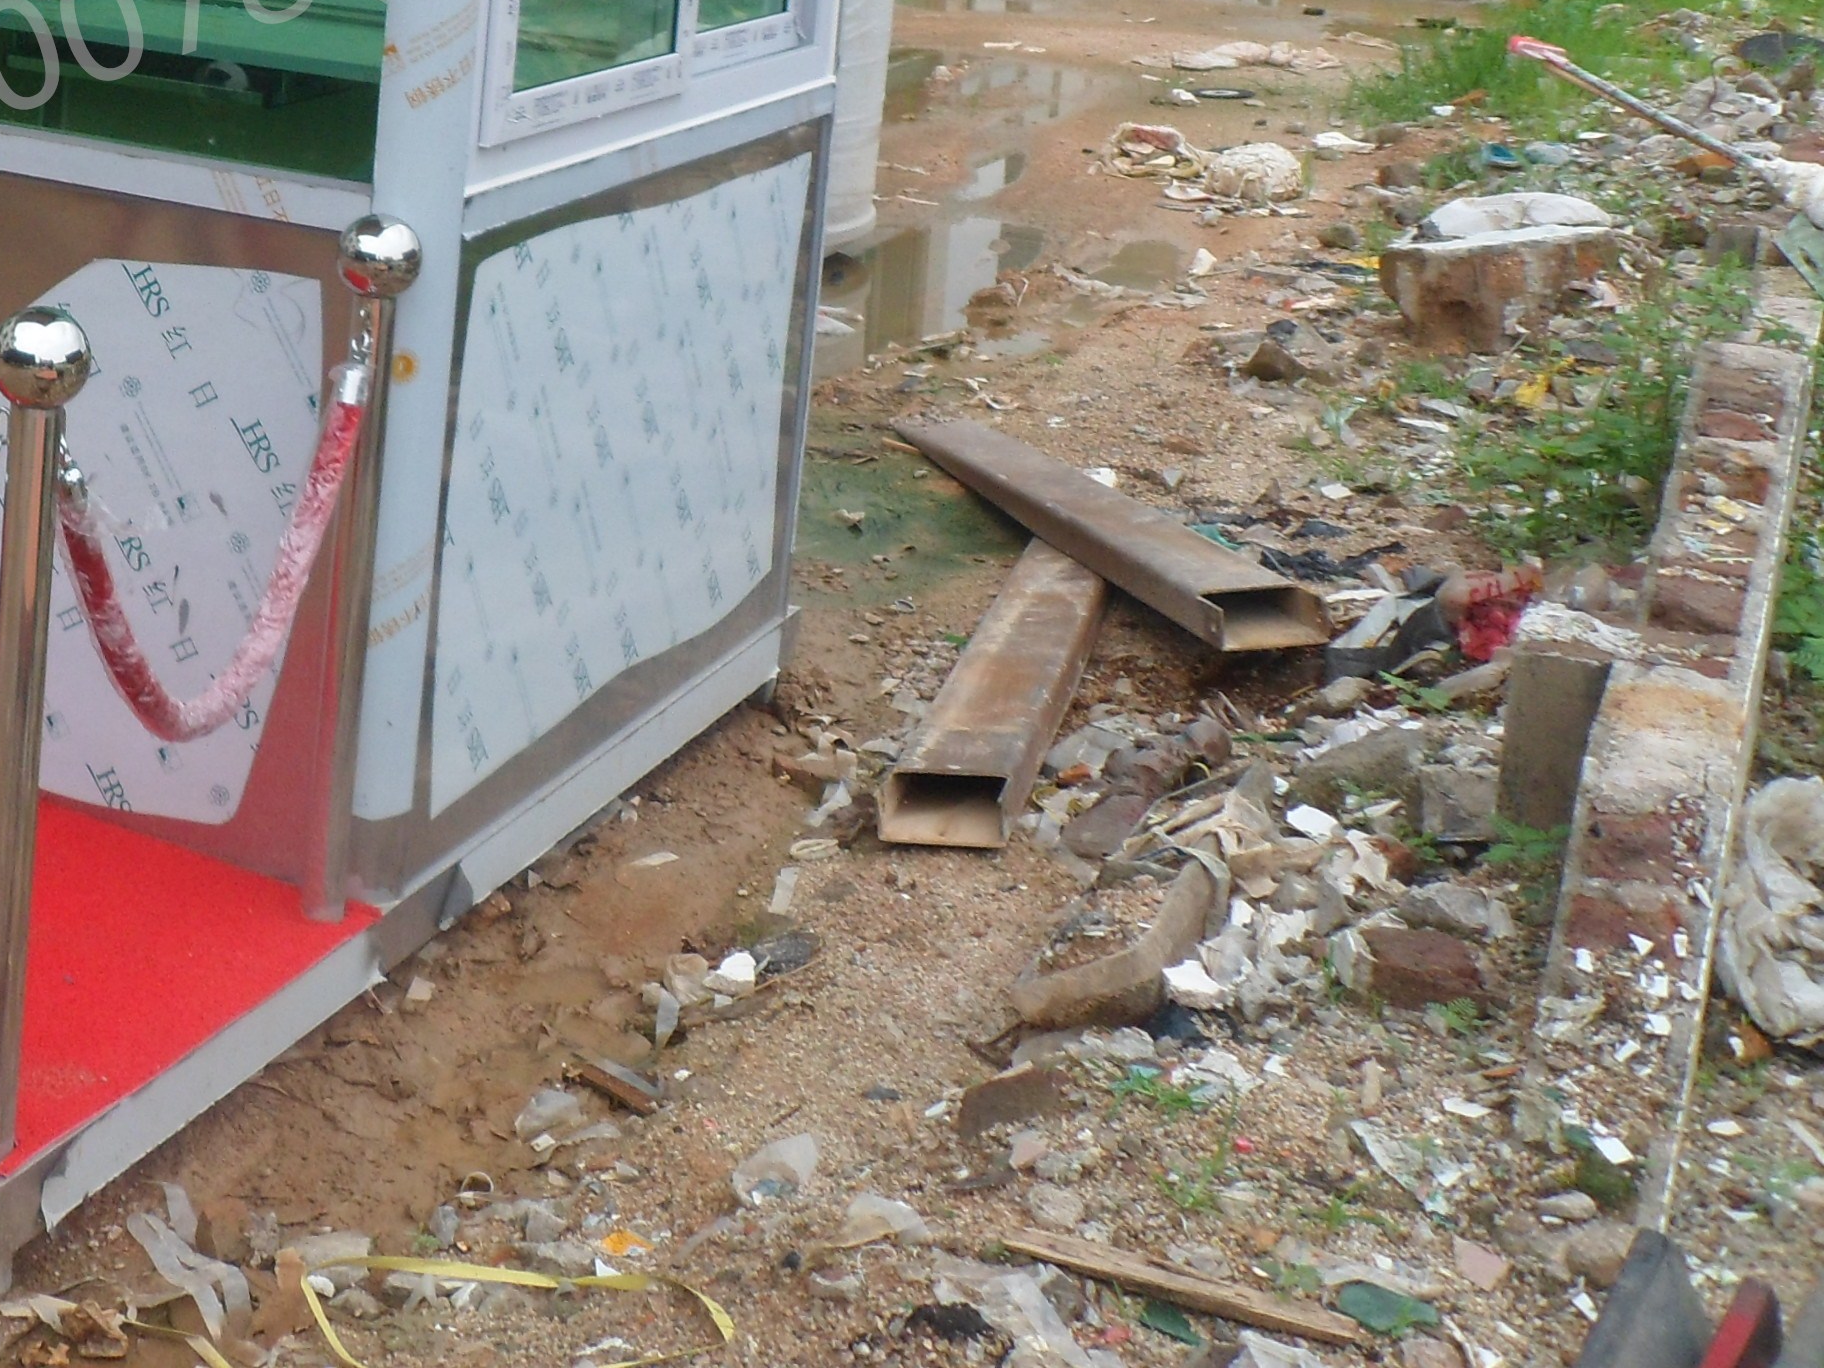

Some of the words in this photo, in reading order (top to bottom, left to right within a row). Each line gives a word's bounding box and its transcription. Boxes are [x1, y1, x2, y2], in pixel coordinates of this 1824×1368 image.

[121, 262, 170, 318] HRS
[230, 417, 280, 474] HRS
[114, 535, 152, 572] RS
